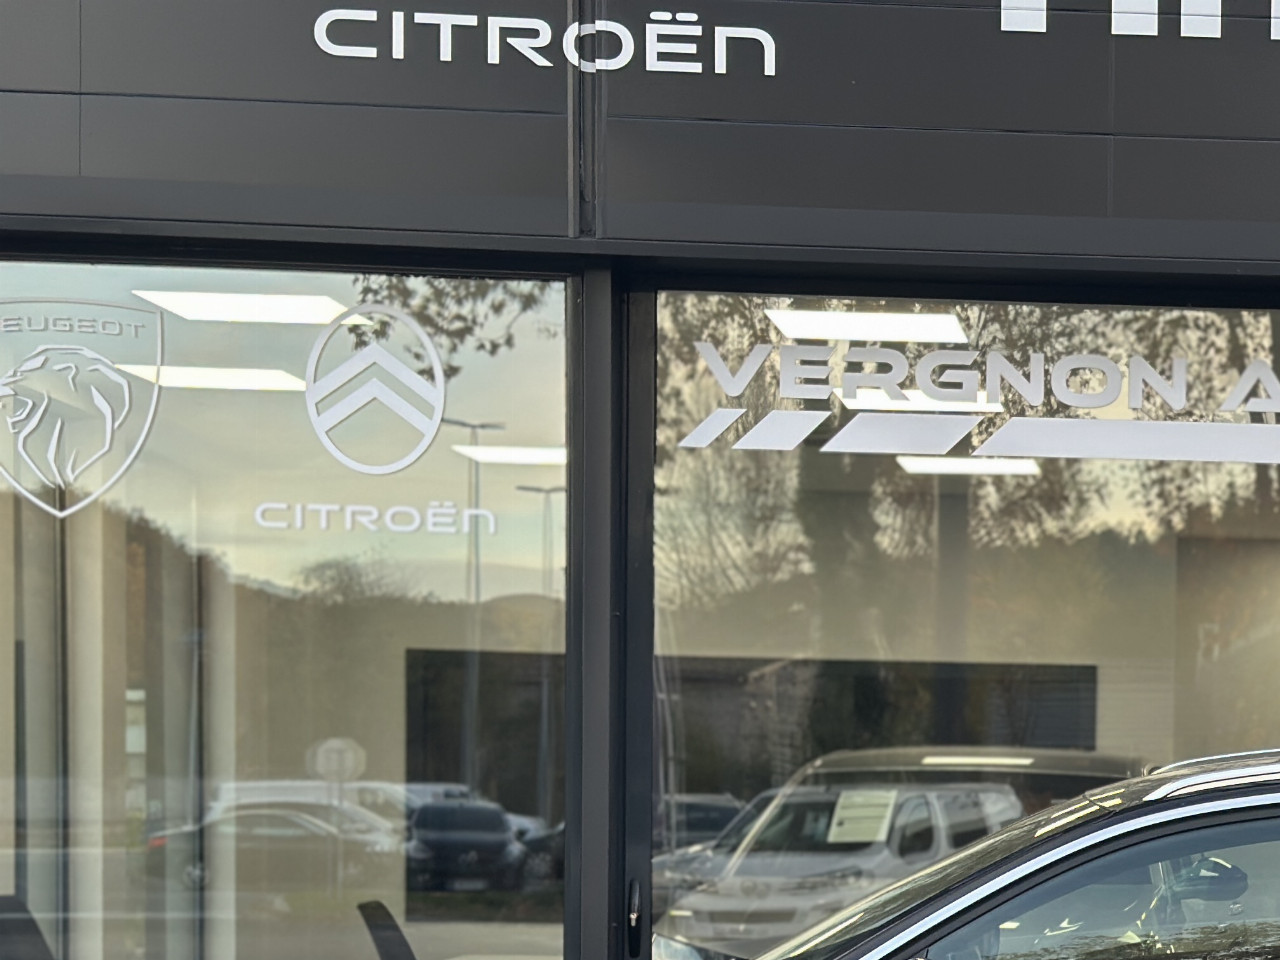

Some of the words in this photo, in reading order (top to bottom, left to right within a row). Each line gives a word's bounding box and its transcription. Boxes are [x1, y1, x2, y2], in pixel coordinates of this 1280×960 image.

[313, 8, 776, 76] CITROËN
[0, 316, 146, 338] EUGEOT
[695, 340, 1188, 411] VERGNON
[254, 502, 497, 535] CITROËN
